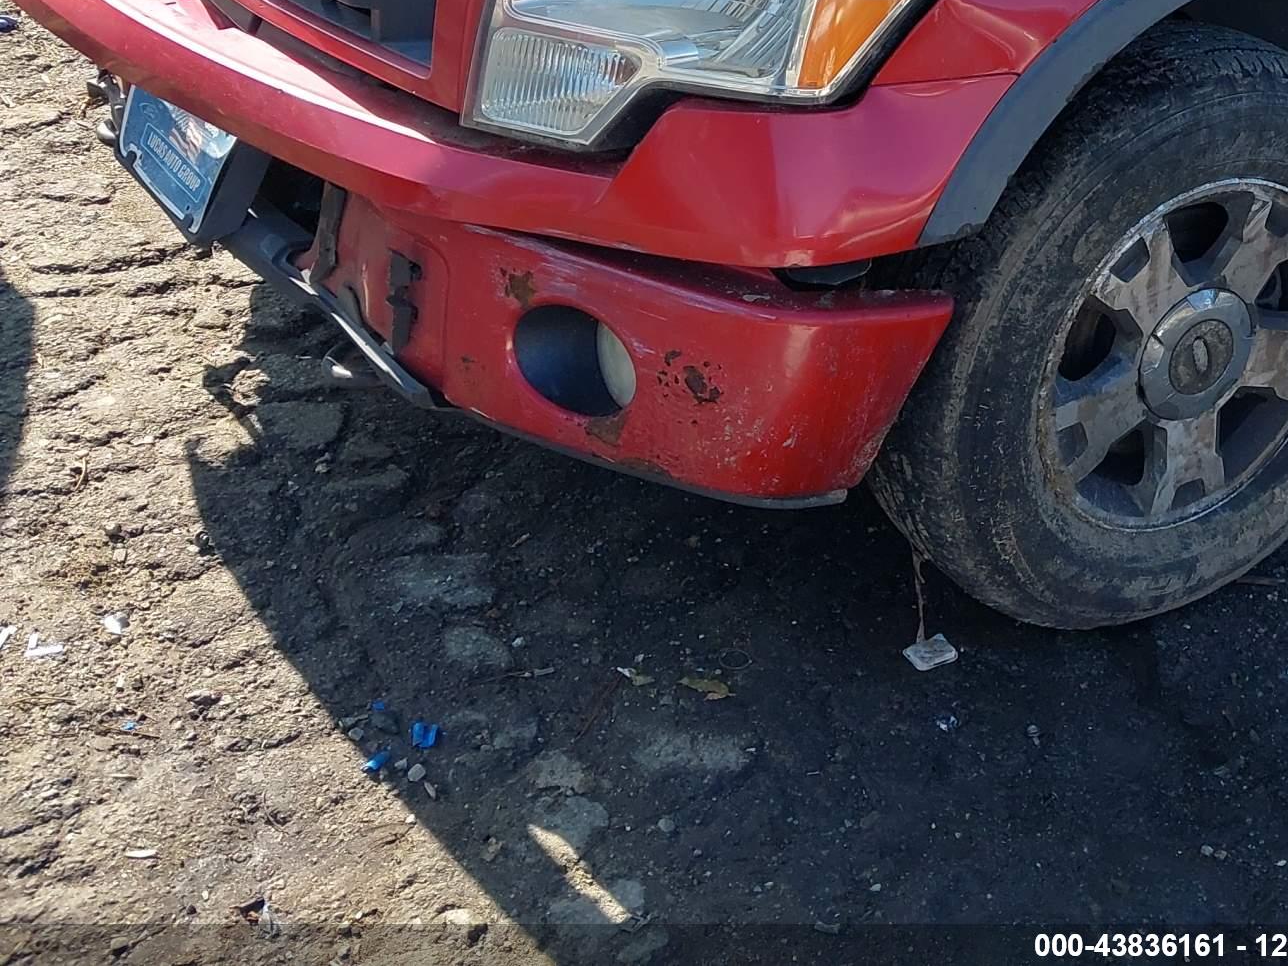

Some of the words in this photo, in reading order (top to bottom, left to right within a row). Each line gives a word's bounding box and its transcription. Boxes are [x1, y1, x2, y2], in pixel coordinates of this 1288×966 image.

[147, 131, 168, 159] LUCAS
[162, 148, 182, 173] AUTO
[177, 163, 201, 192] GROUP
